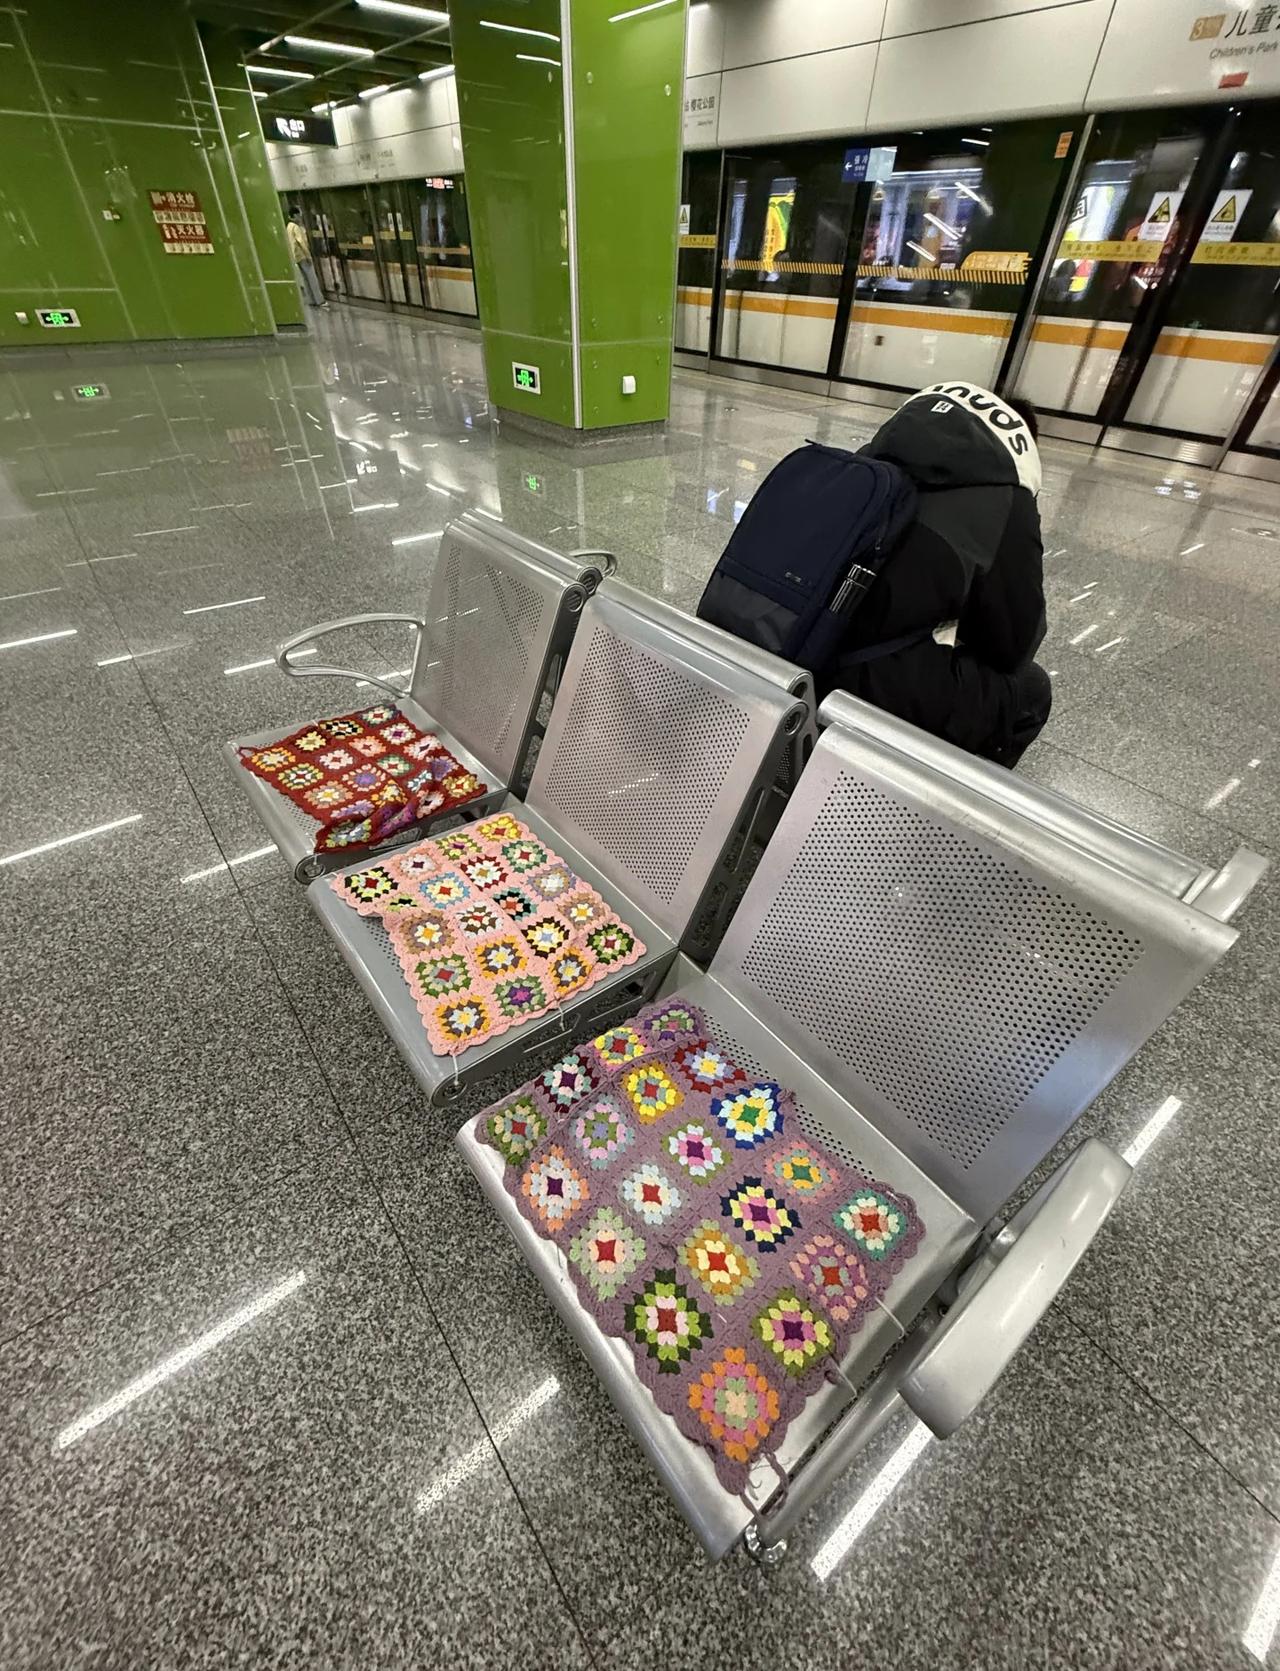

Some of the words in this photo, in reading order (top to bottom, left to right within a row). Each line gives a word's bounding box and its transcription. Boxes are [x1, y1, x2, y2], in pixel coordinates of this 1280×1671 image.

[1224, 4, 1280, 39] 儿童
[1209, 44, 1254, 60] Children's
[1255, 41, 1279, 53] Park
